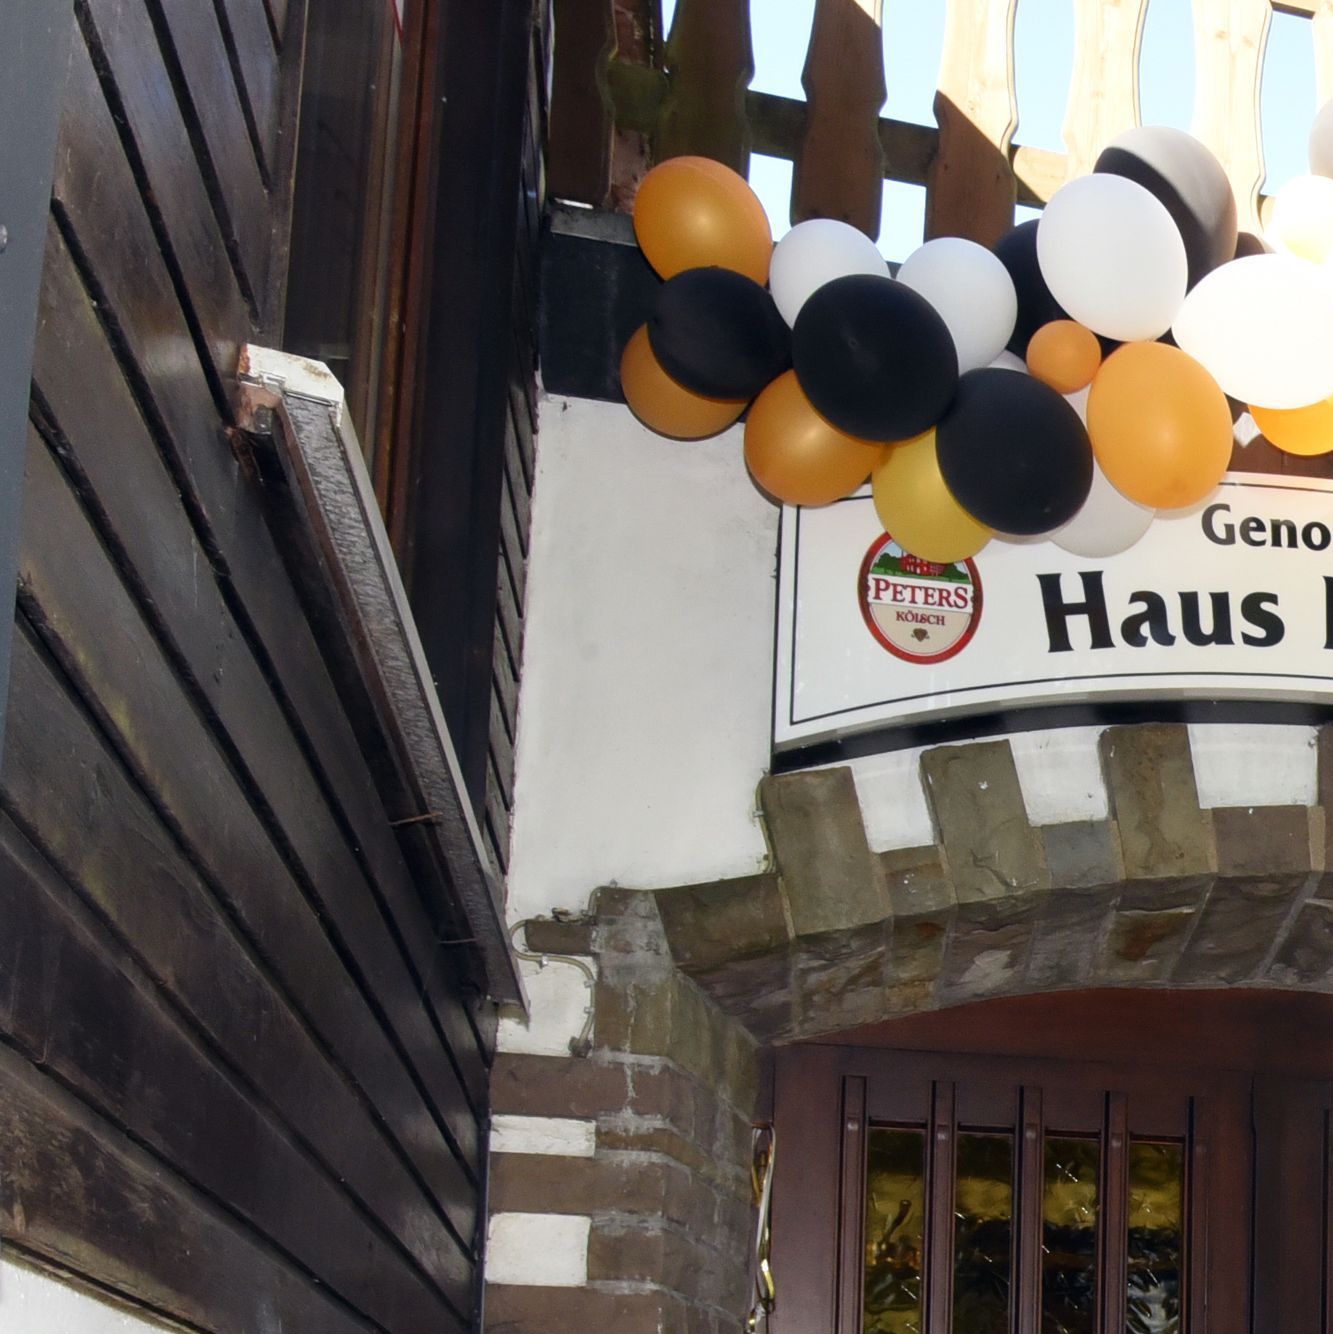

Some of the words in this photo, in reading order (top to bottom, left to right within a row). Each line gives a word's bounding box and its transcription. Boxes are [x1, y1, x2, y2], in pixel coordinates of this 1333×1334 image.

[872, 577, 969, 610] PETERS
[895, 609, 946, 626] KÖLSCH
[1036, 570, 1285, 653] Haus
